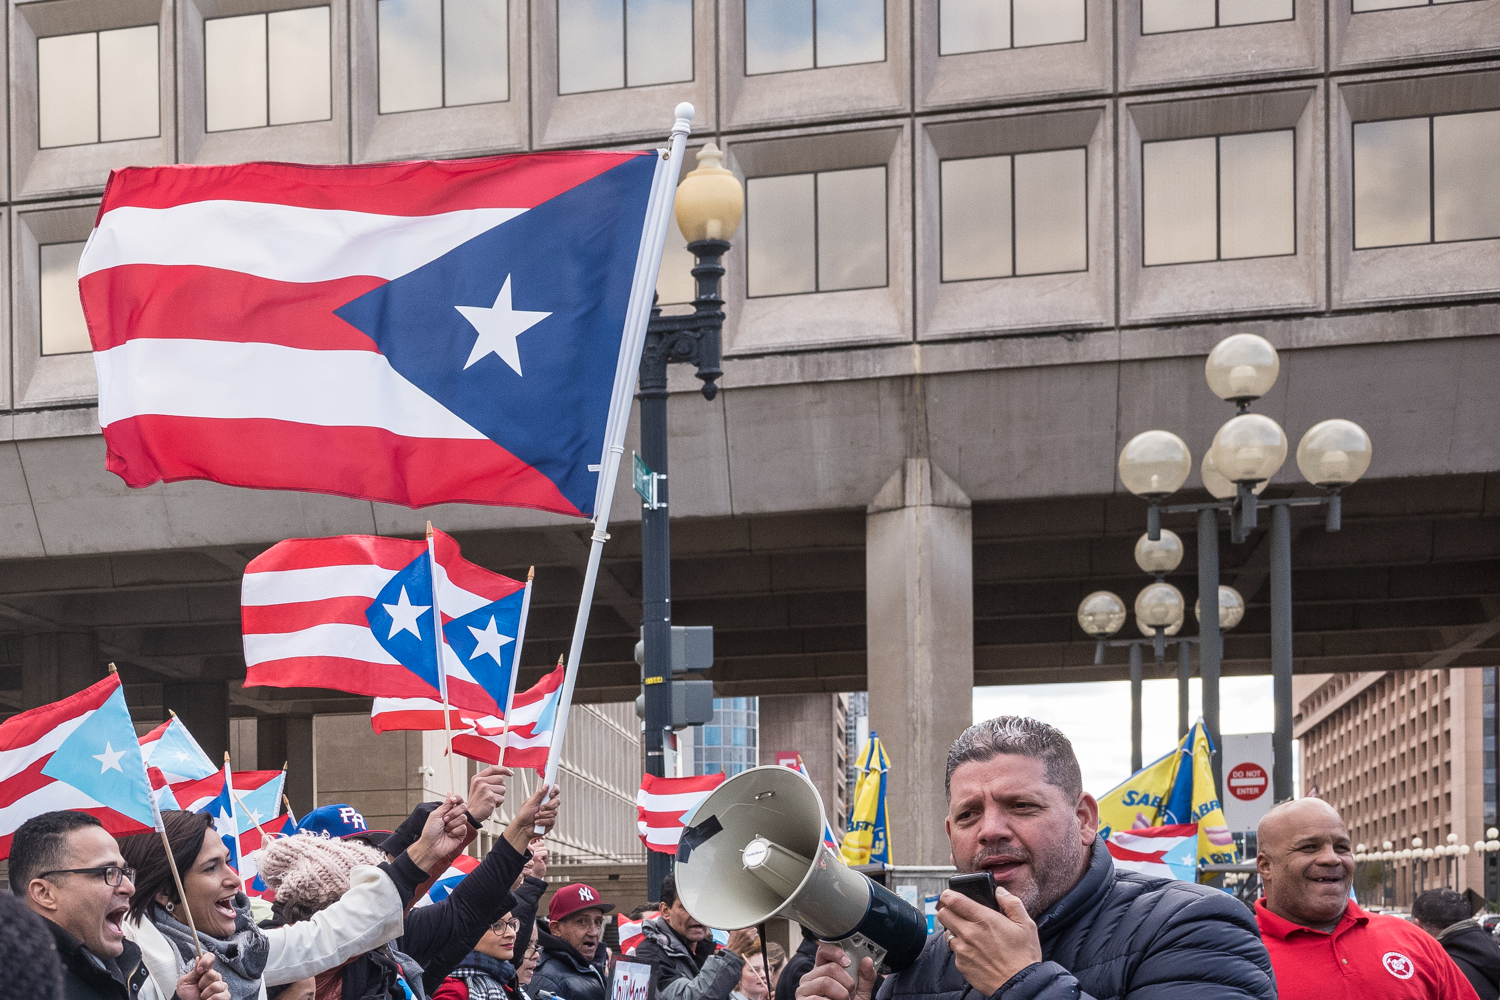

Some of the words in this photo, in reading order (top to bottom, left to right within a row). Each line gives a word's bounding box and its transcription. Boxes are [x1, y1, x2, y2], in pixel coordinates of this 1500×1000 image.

[1236, 787, 1260, 795] ENTER
[338, 806, 367, 831] PR
[578, 886, 595, 901] NY
